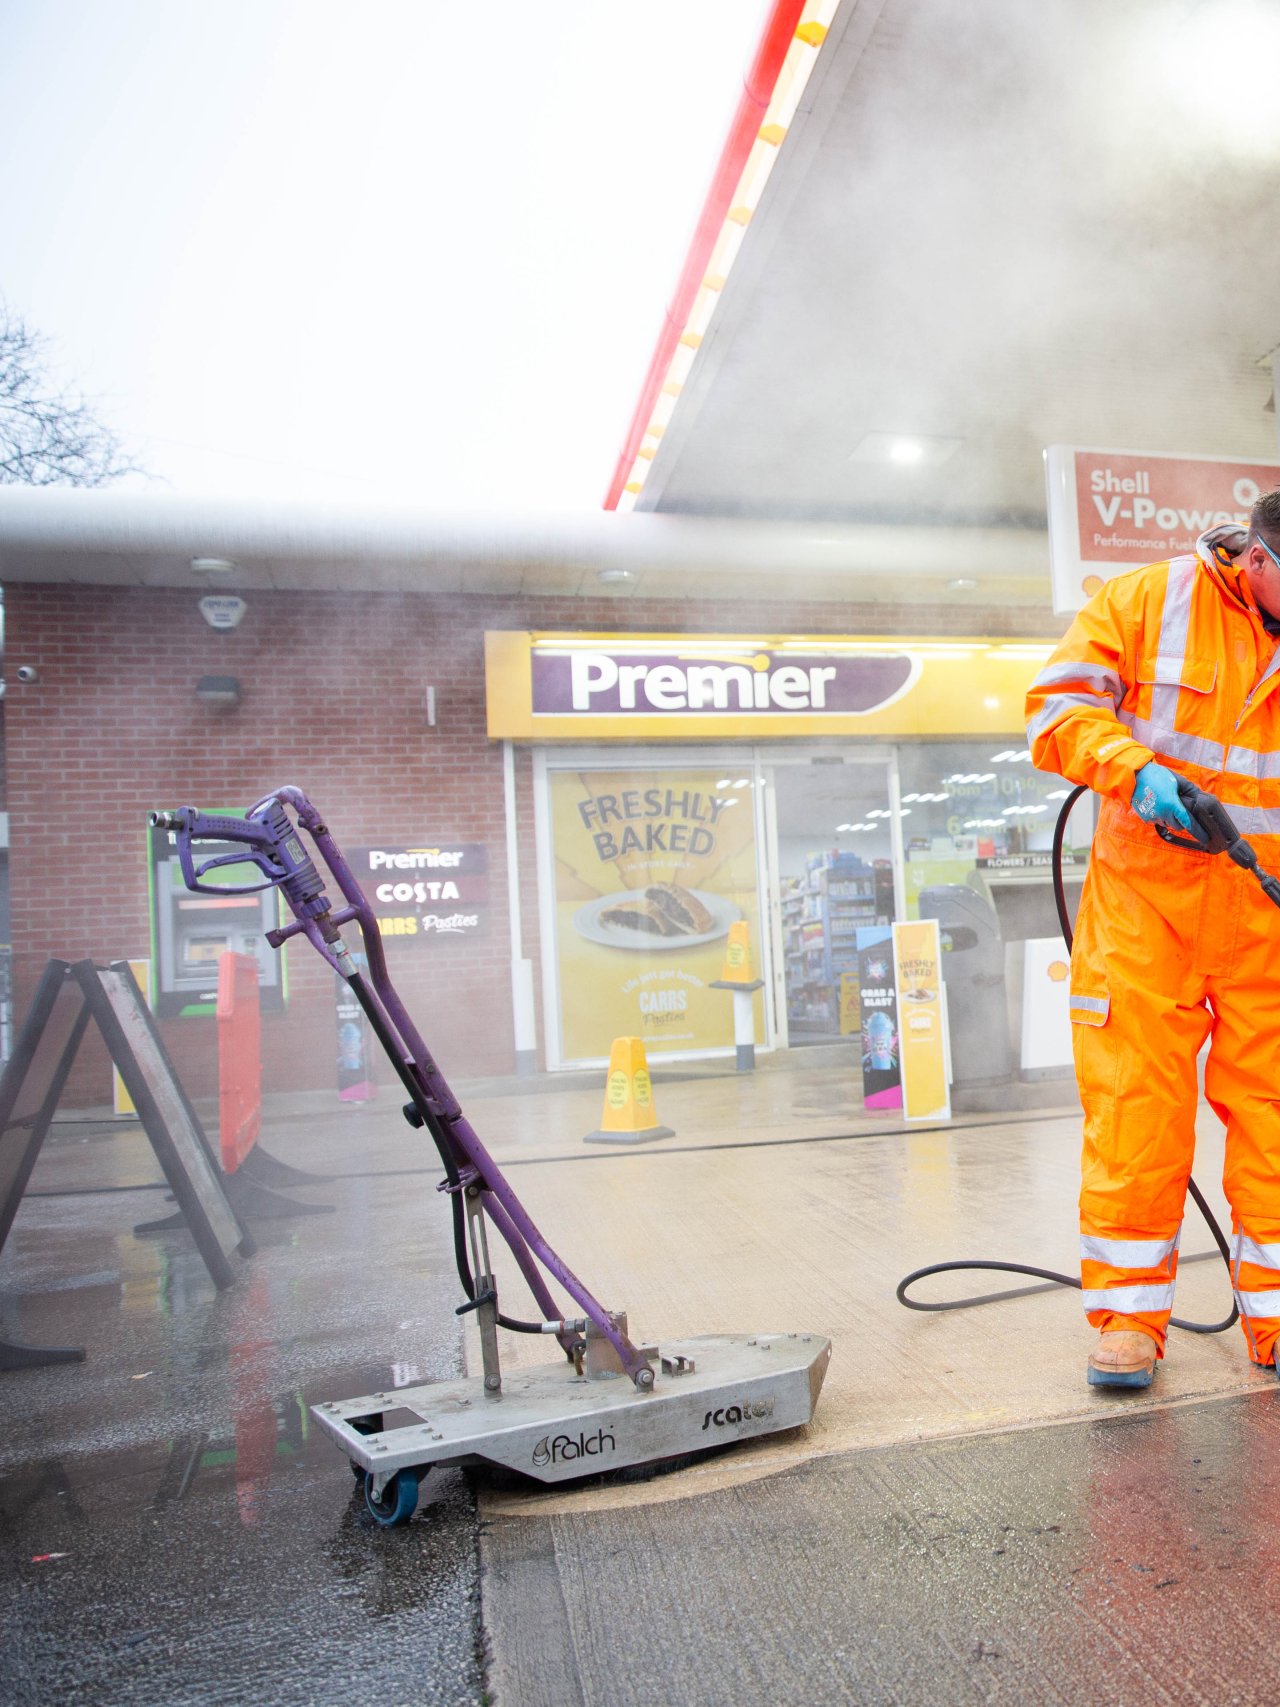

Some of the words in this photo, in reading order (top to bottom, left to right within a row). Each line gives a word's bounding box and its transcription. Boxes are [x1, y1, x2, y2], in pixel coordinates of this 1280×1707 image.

[1091, 469, 1149, 494] Shell
[1094, 533, 1166, 550] Performance
[570, 653, 836, 710] Premier
[578, 789, 727, 829] FRESHLY
[593, 824, 714, 861] BAKED
[369, 848, 464, 870] Premier
[1032, 855, 1075, 866] SEASAL
[376, 881, 459, 903] COSTA
[359, 916, 418, 936] RRS
[422, 913, 478, 932] Pasties
[903, 969, 932, 978] BAKED
[639, 989, 688, 1013] CARRS
[861, 989, 886, 997] GRAB
[864, 998, 893, 1006] BLAST
[552, 1427, 616, 1464] falch
